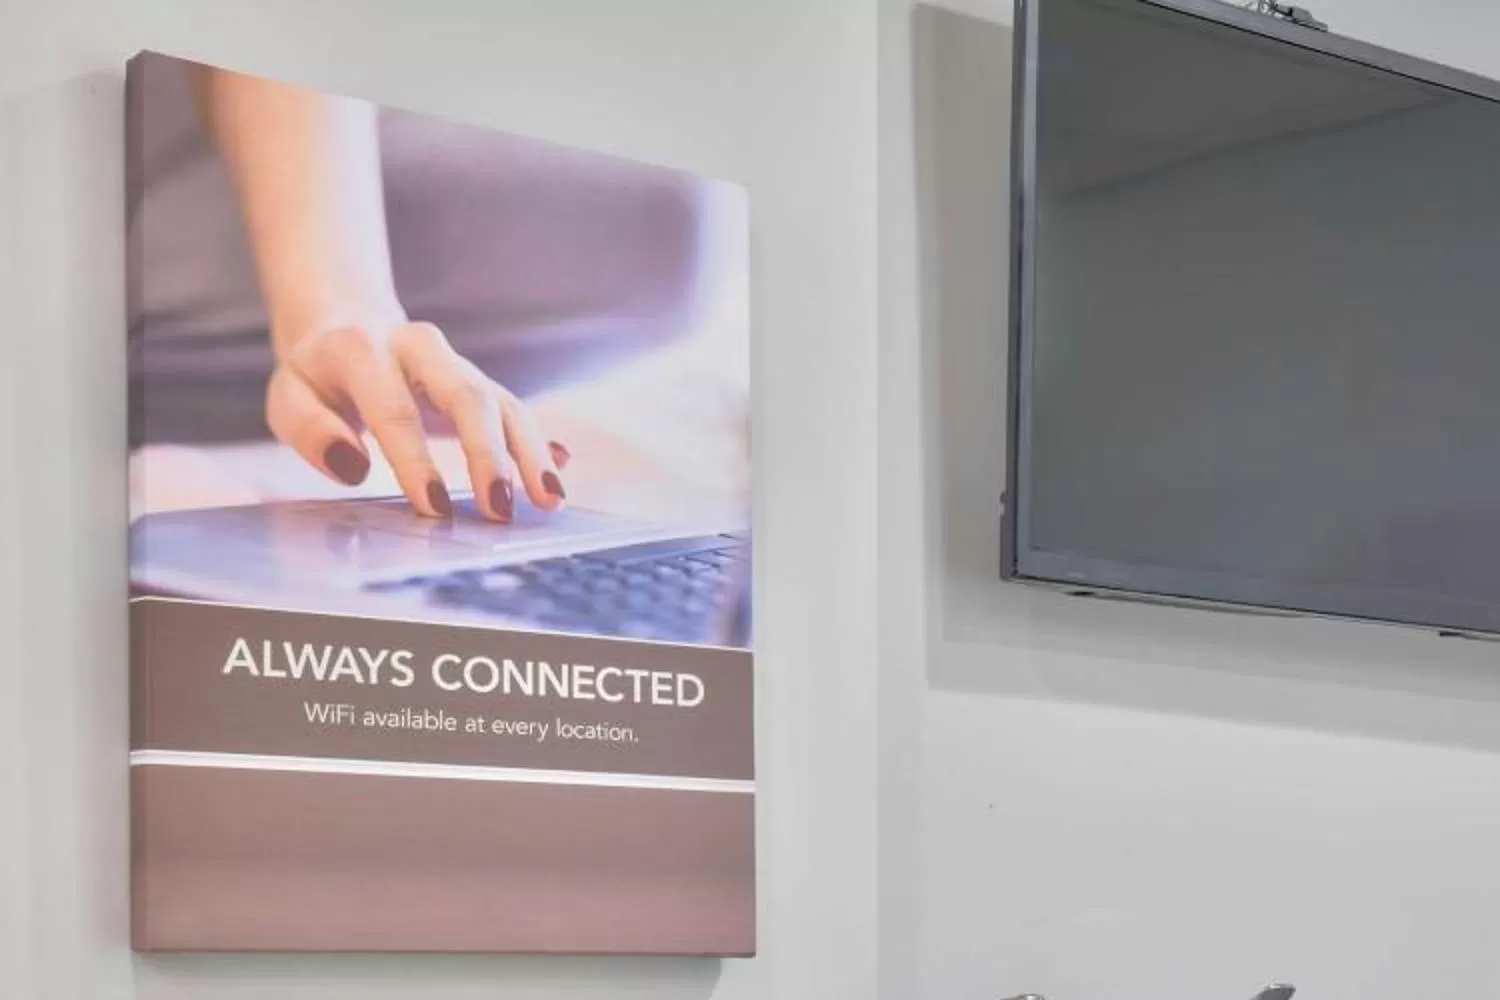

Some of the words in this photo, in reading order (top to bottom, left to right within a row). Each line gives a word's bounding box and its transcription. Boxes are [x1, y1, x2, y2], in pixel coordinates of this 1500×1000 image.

[222, 638, 415, 688] ALWAYS
[431, 654, 705, 708] CONNECTED
[303, 702, 355, 725] WiFi
[363, 708, 457, 732] available
[464, 715, 486, 733] at
[491, 719, 549, 743] every
[555, 717, 640, 743] location.
